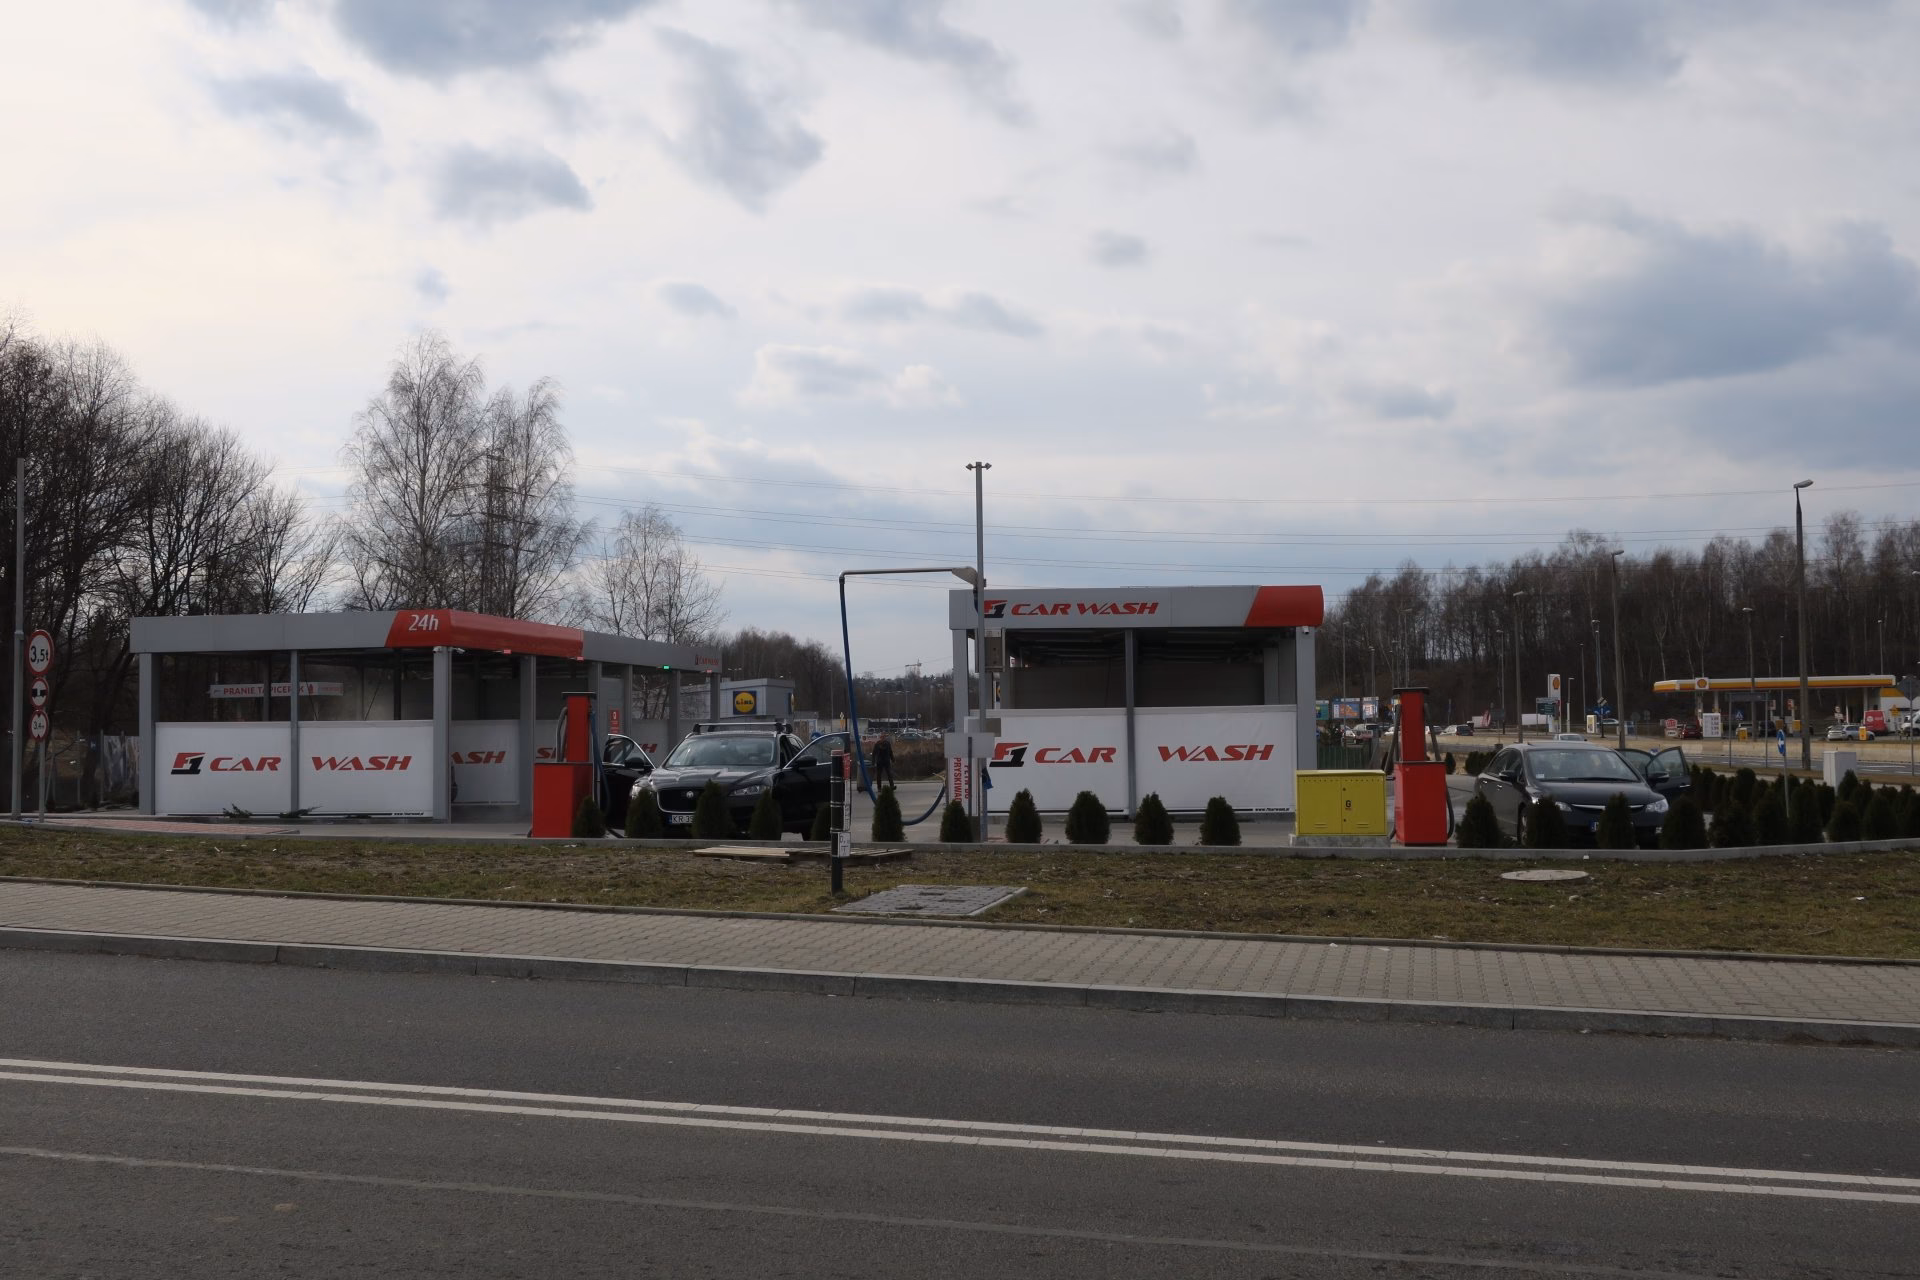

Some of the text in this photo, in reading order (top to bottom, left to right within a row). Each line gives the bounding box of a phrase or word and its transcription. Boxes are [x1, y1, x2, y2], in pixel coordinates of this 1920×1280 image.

[1011, 603, 1072, 616] CAR
[1076, 602, 1159, 615] WASH
[409, 614, 439, 631] 24h
[224, 686, 256, 695] PRANIE
[1035, 747, 1117, 763] CAR
[1157, 745, 1275, 761] WASH
[209, 757, 282, 772] CAR
[311, 755, 412, 771] WASH
